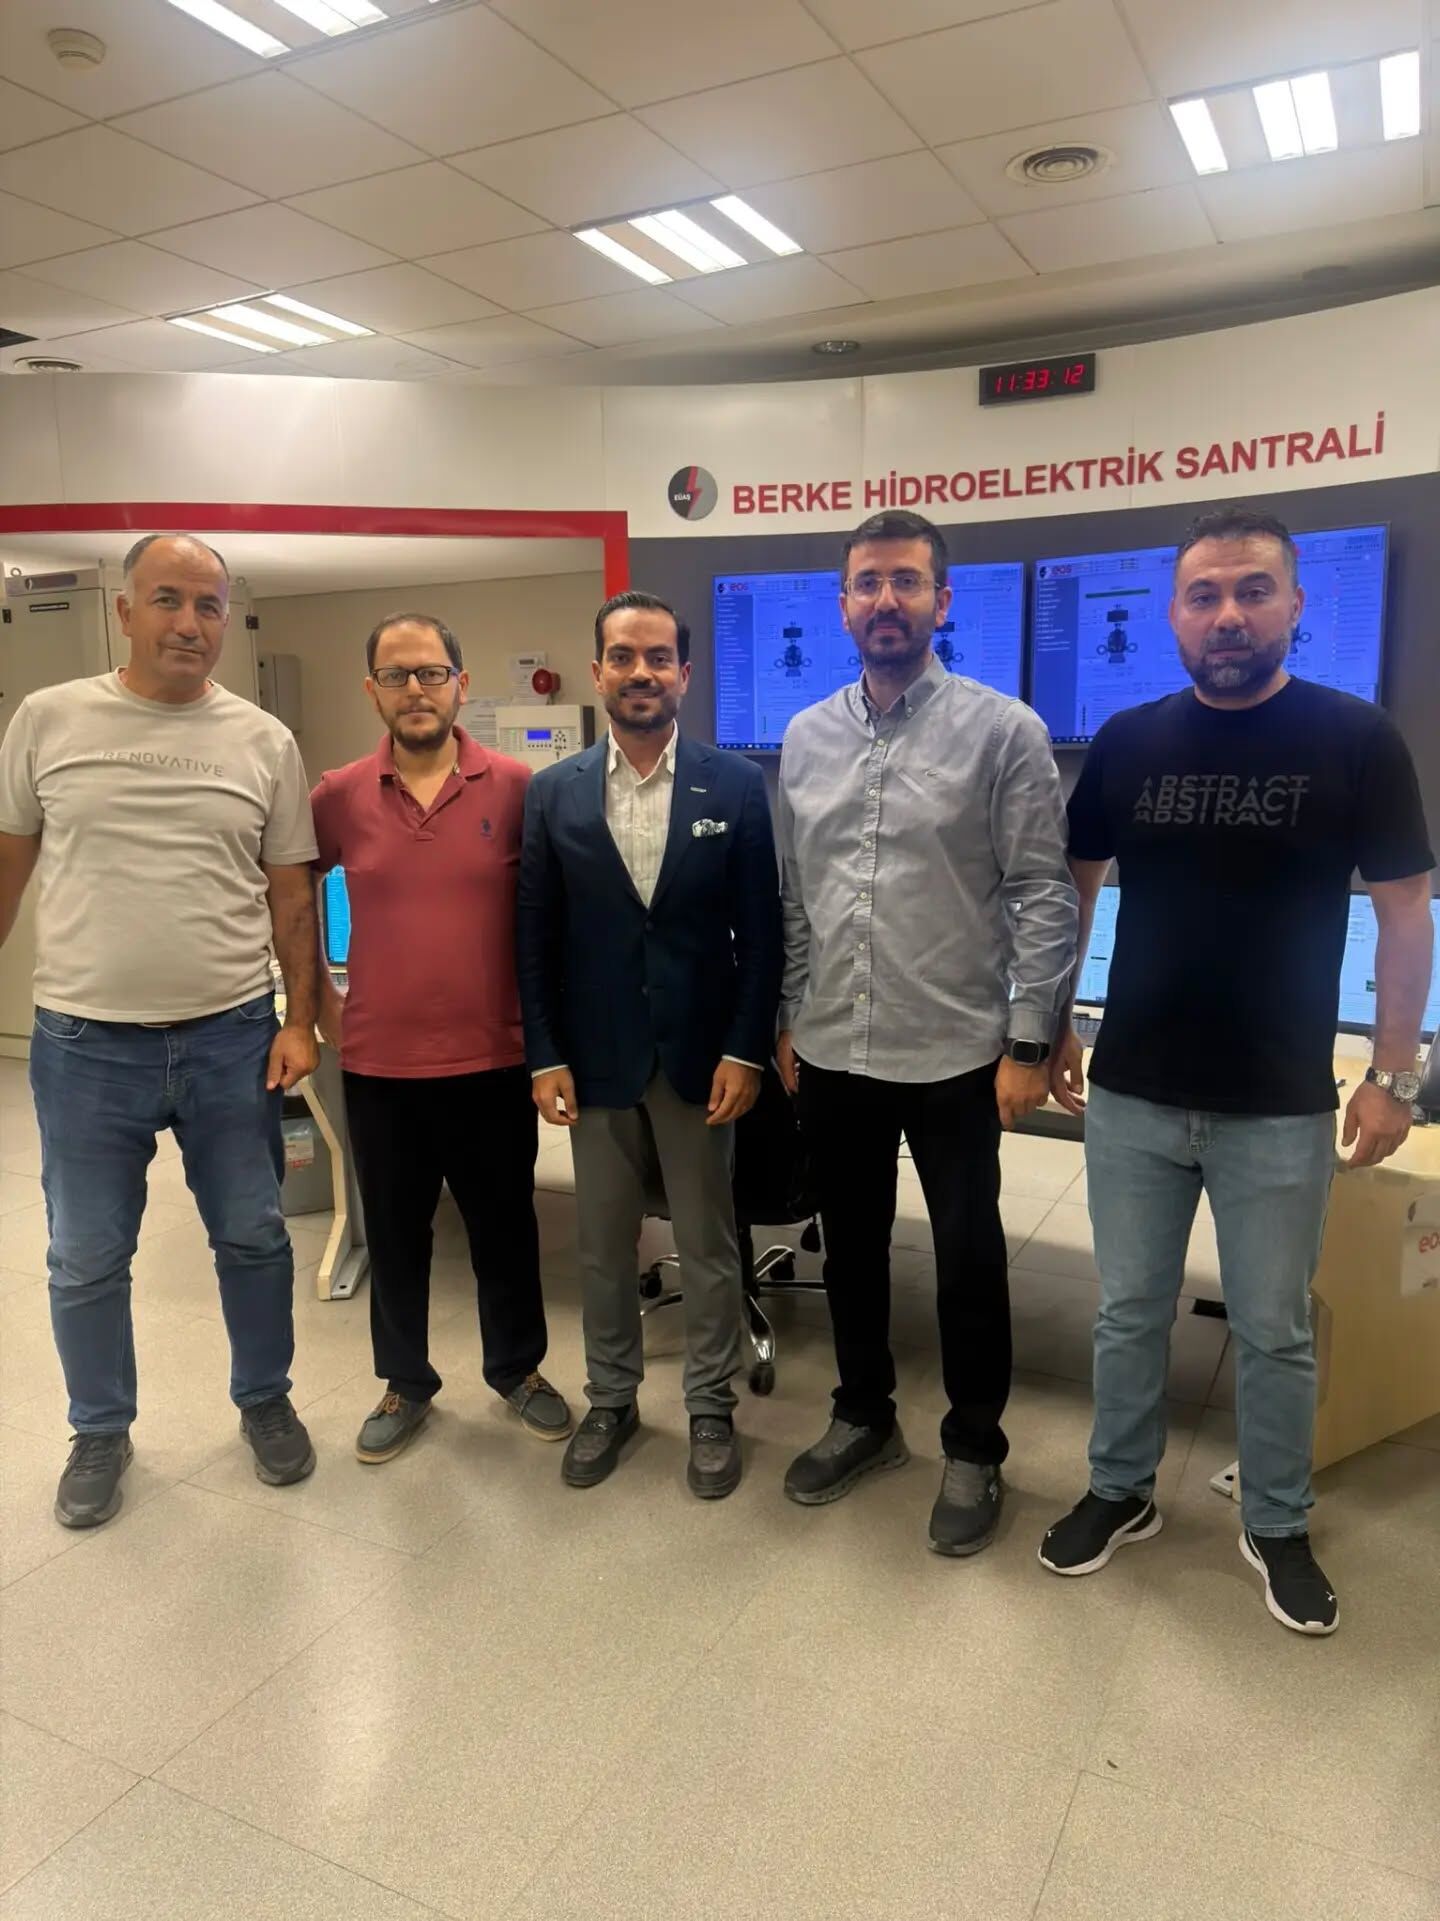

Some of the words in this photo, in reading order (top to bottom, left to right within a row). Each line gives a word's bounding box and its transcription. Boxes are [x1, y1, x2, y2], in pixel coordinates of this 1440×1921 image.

[994, 364, 1086, 394] 11:33:12
[733, 480, 852, 514] BERKE
[864, 446, 1164, 509] HİDROELEKTRİK
[1175, 410, 1385, 479] SANTRALİ
[1133, 786, 1311, 815] ABSTRACT
[1418, 1231, 1440, 1254] eo
